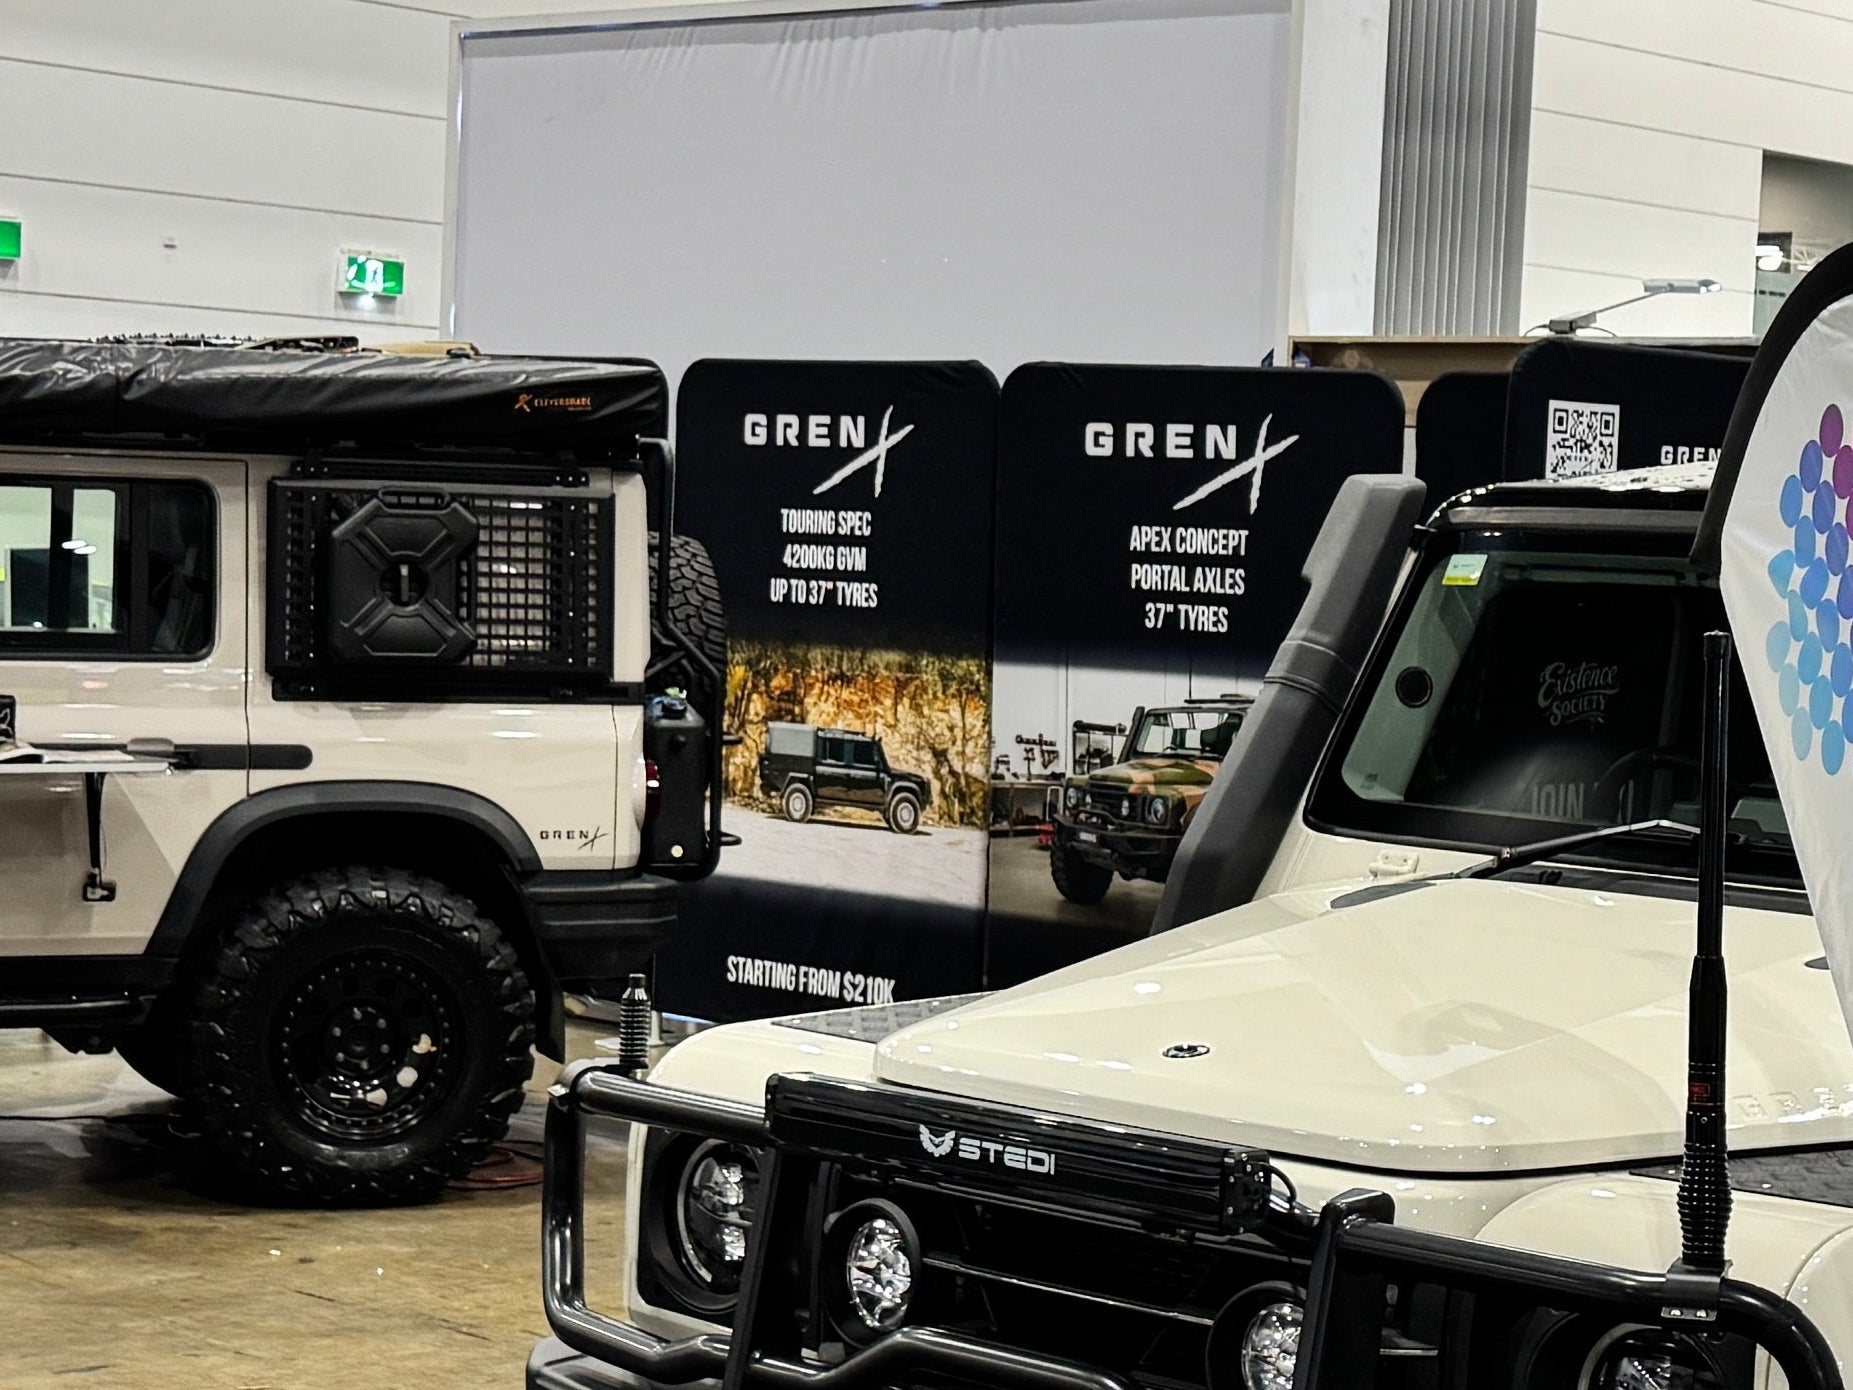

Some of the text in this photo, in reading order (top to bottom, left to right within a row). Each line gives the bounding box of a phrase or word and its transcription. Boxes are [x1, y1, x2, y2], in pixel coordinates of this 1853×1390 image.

[781, 508, 872, 537] TOURING SPEC
[1130, 525, 1249, 556] APEX CONCEPT
[783, 544, 867, 572] 4200KG GVM
[770, 578, 788, 603] UP
[790, 579, 807, 604] TO
[836, 582, 878, 608] TYRES
[1131, 563, 1245, 595] PORTAL AXLES
[1178, 604, 1229, 632] TYRES
[1537, 661, 1620, 709] Existence
[1549, 694, 1608, 727] SOCIETY
[727, 955, 896, 1004] STARTING FROM $210K
[958, 1137, 1056, 1176] STEDI
